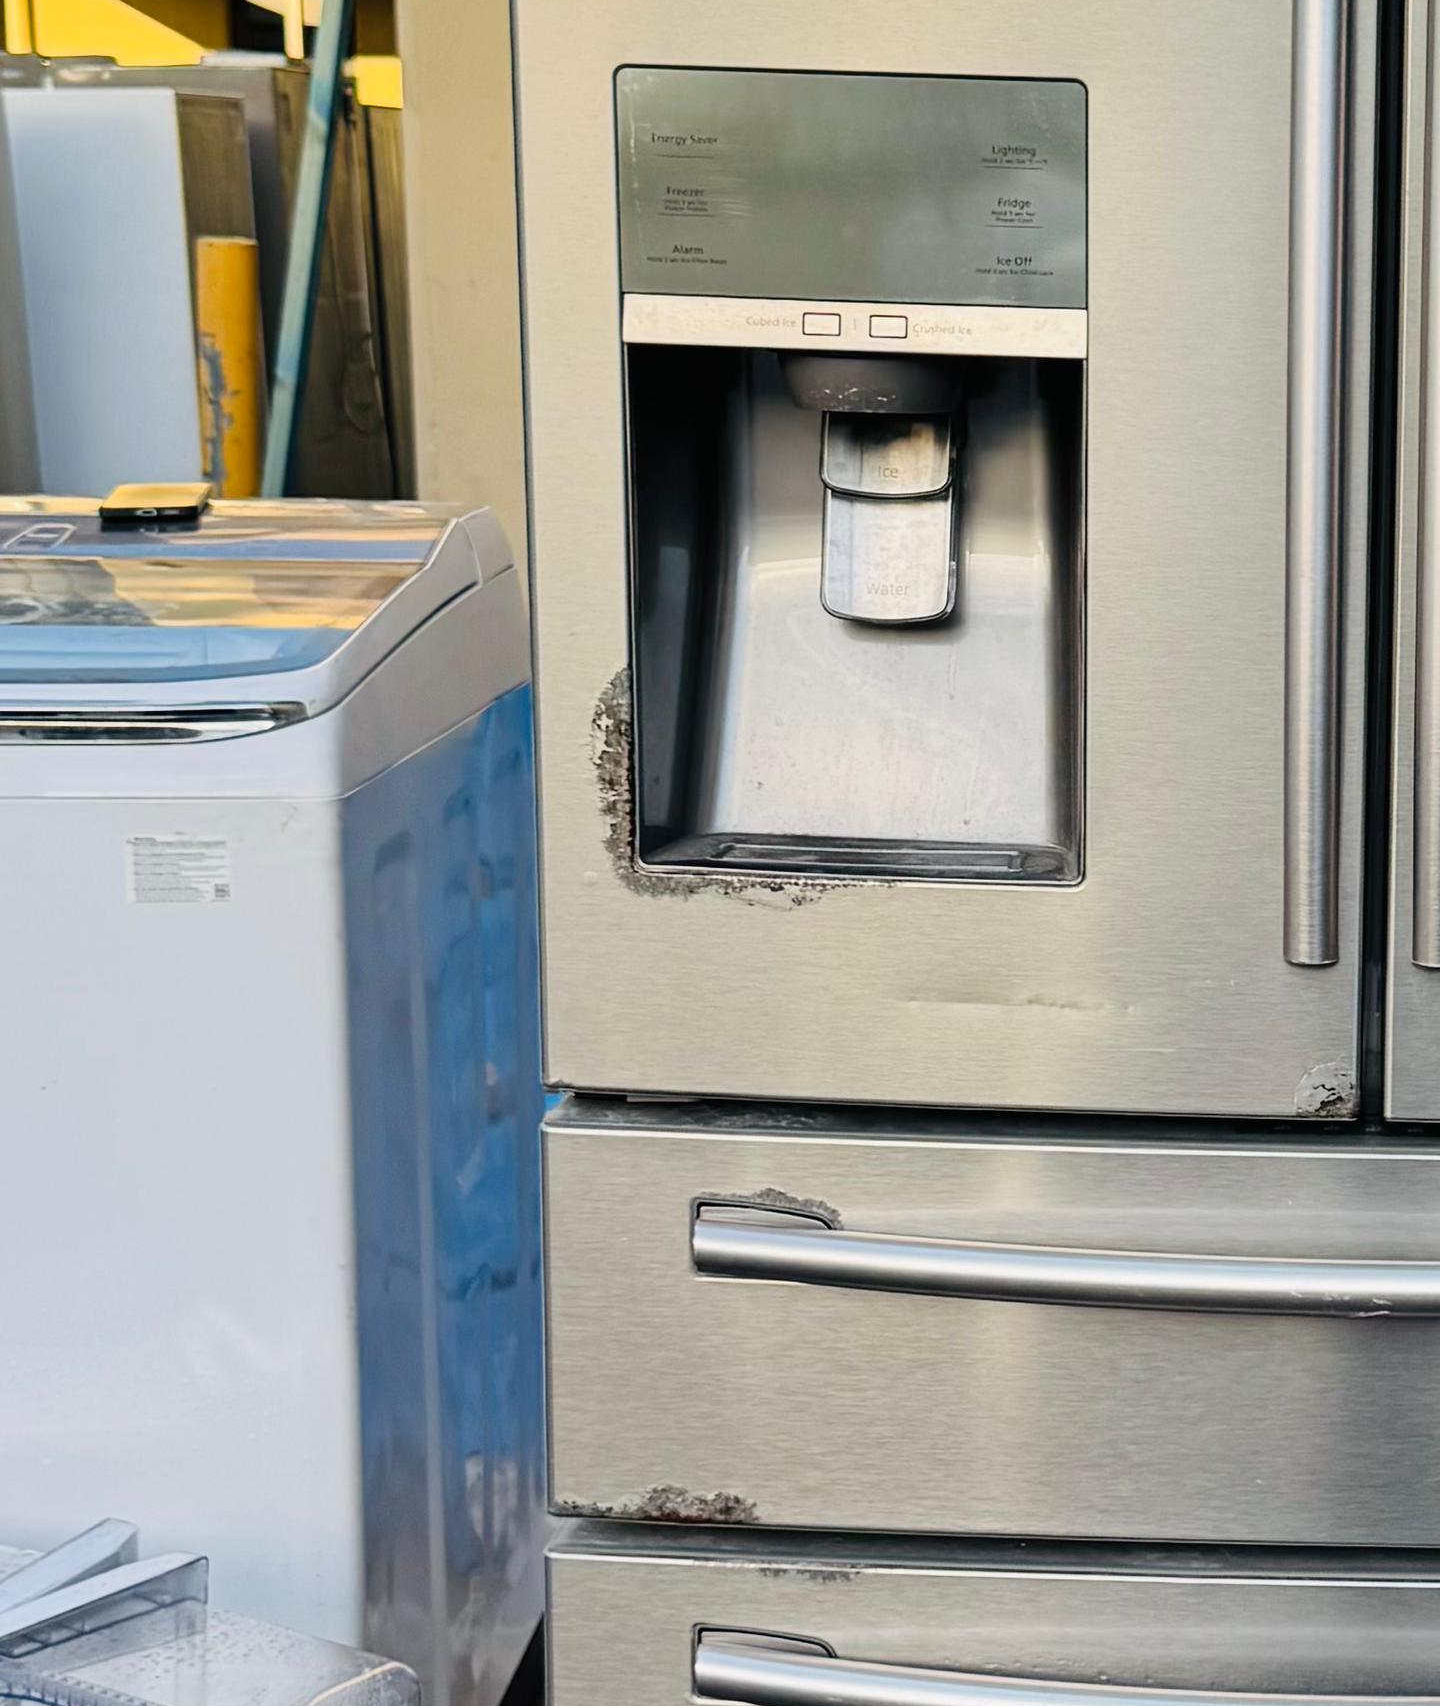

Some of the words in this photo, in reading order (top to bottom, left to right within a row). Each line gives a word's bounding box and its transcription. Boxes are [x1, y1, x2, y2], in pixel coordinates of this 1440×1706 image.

[991, 145, 1037, 158] Lighting
[997, 197, 1032, 210] Fridge
[672, 244, 704, 255] Alarm
[996, 256, 1012, 266] Ice
[1014, 256, 1032, 267] Off
[745, 316, 780, 327] Cubed
[912, 323, 955, 335] Crushed
[878, 465, 899, 478] Ice
[865, 582, 911, 597] Water
